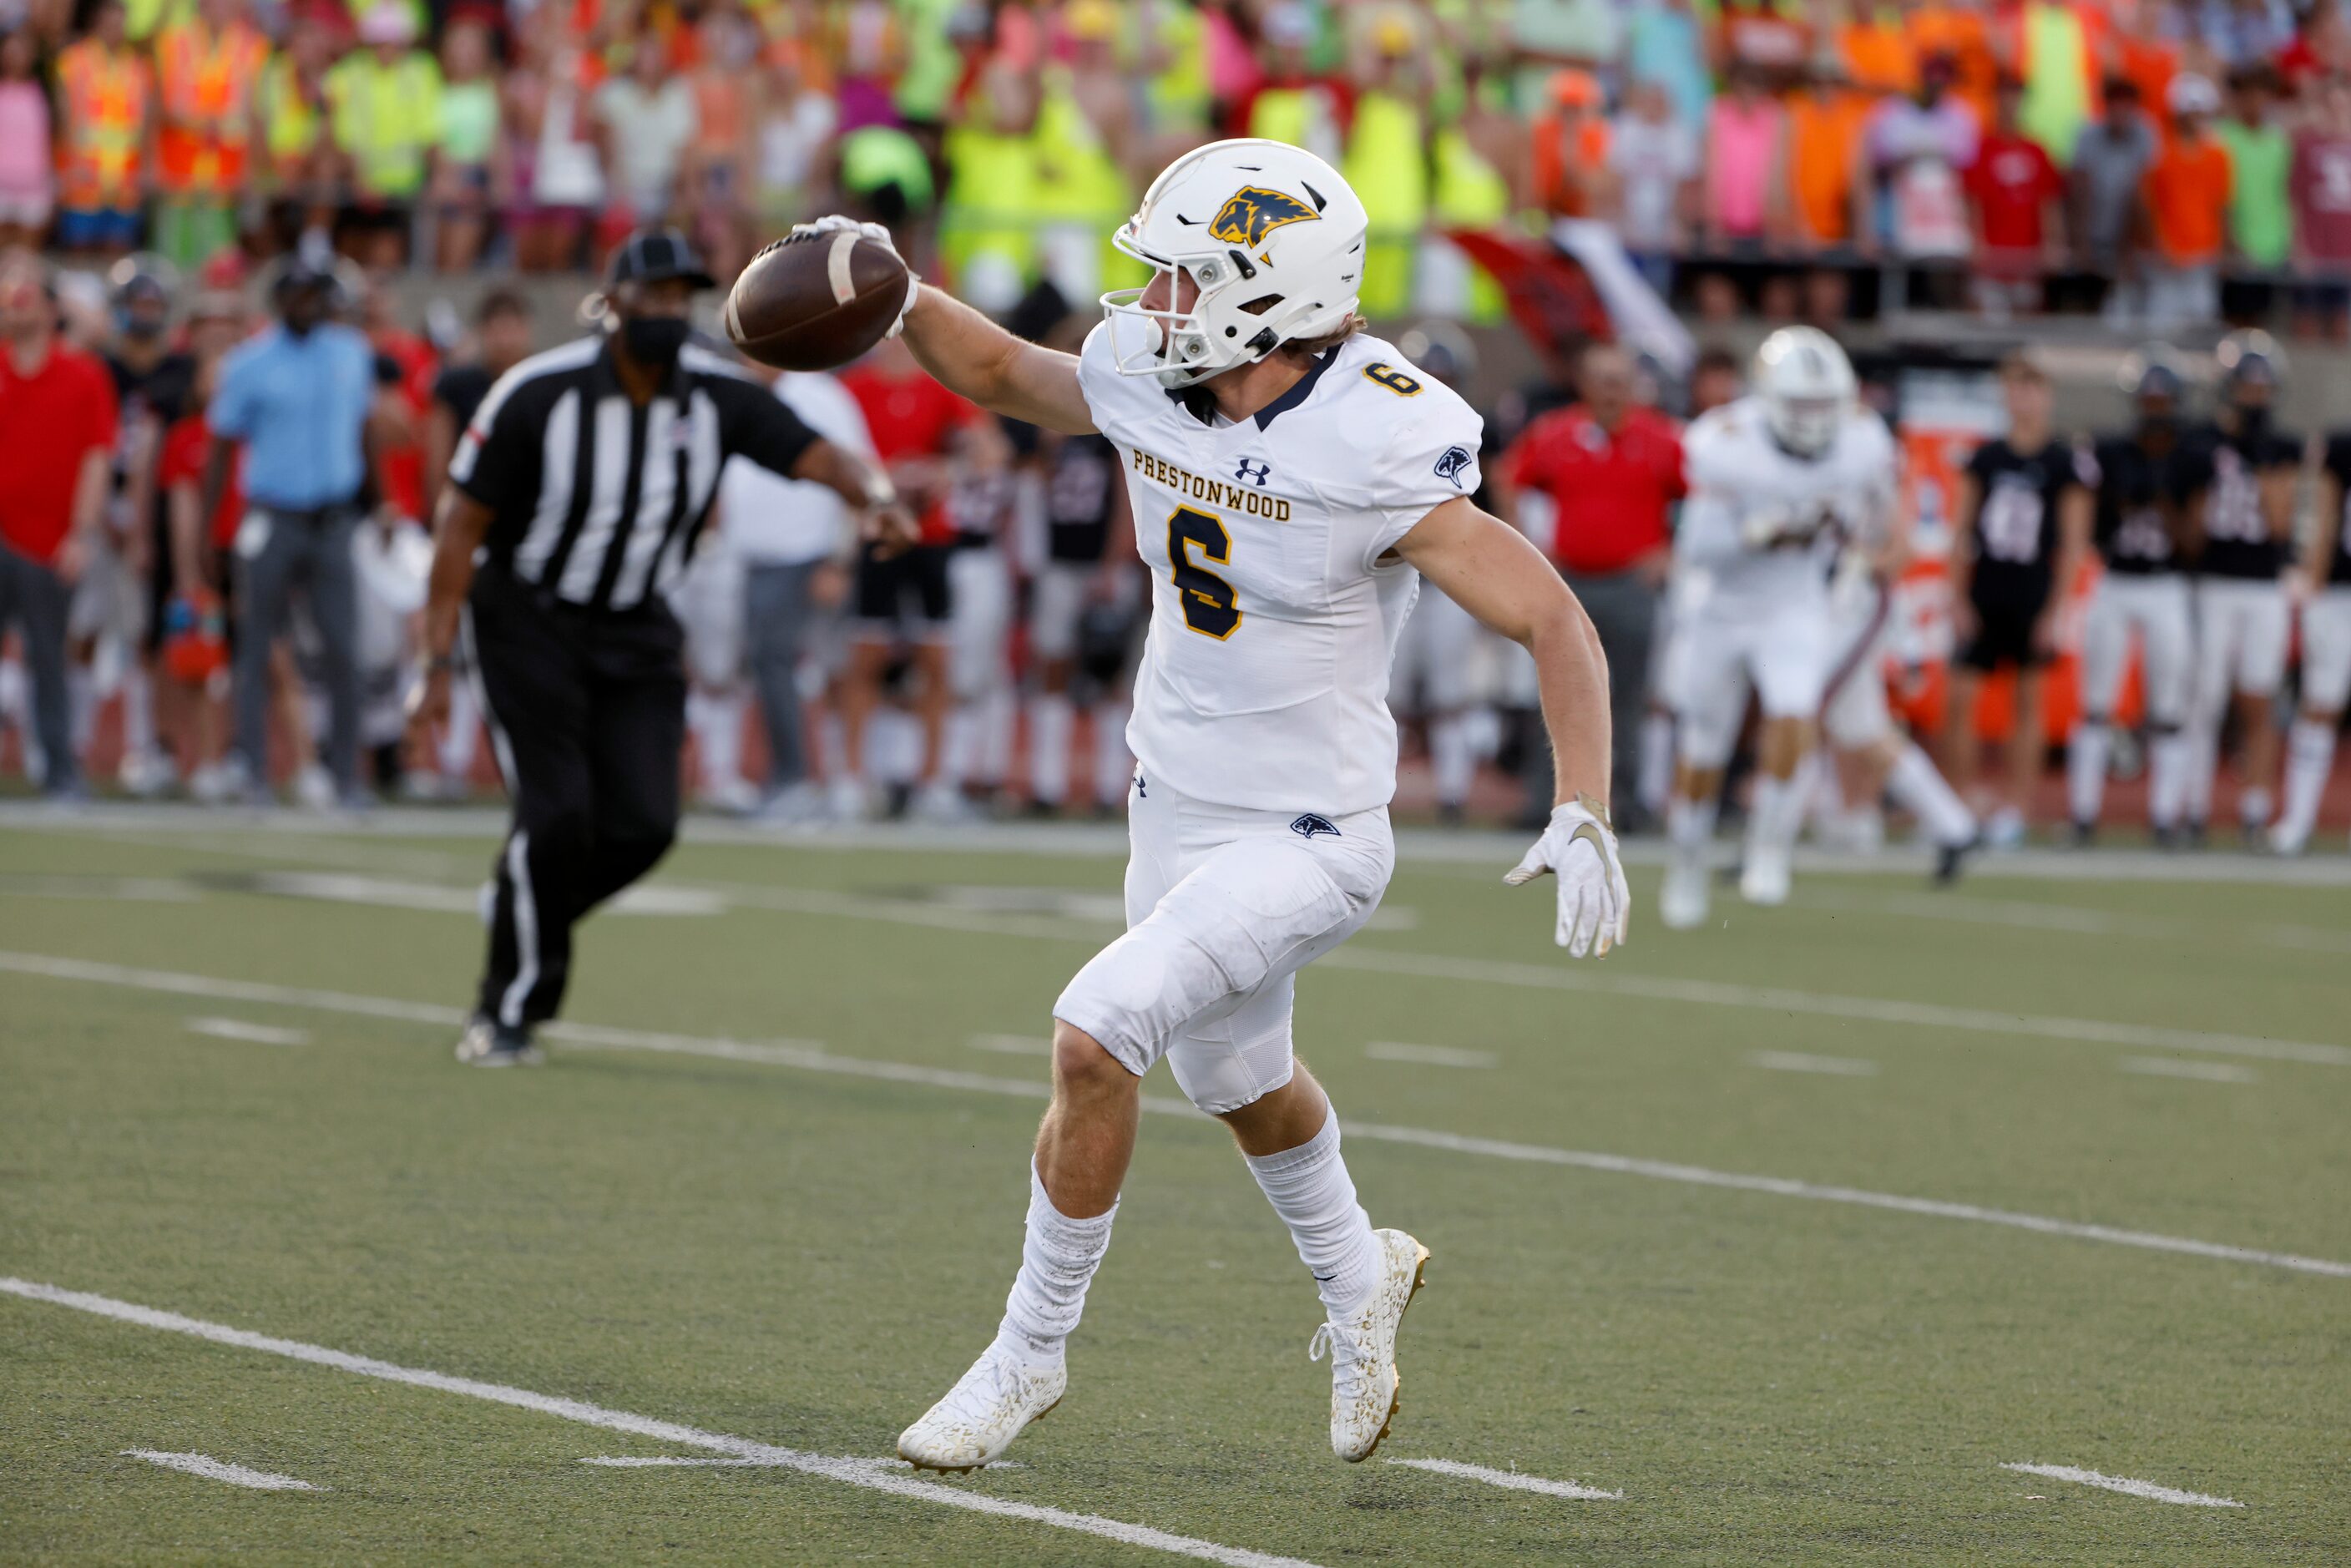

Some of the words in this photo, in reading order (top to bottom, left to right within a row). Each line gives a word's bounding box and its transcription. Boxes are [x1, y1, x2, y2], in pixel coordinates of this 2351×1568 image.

[1362, 362, 1424, 397] 6
[1133, 448, 1290, 522] PRESTONWOOD
[1167, 503, 1243, 642] 6
